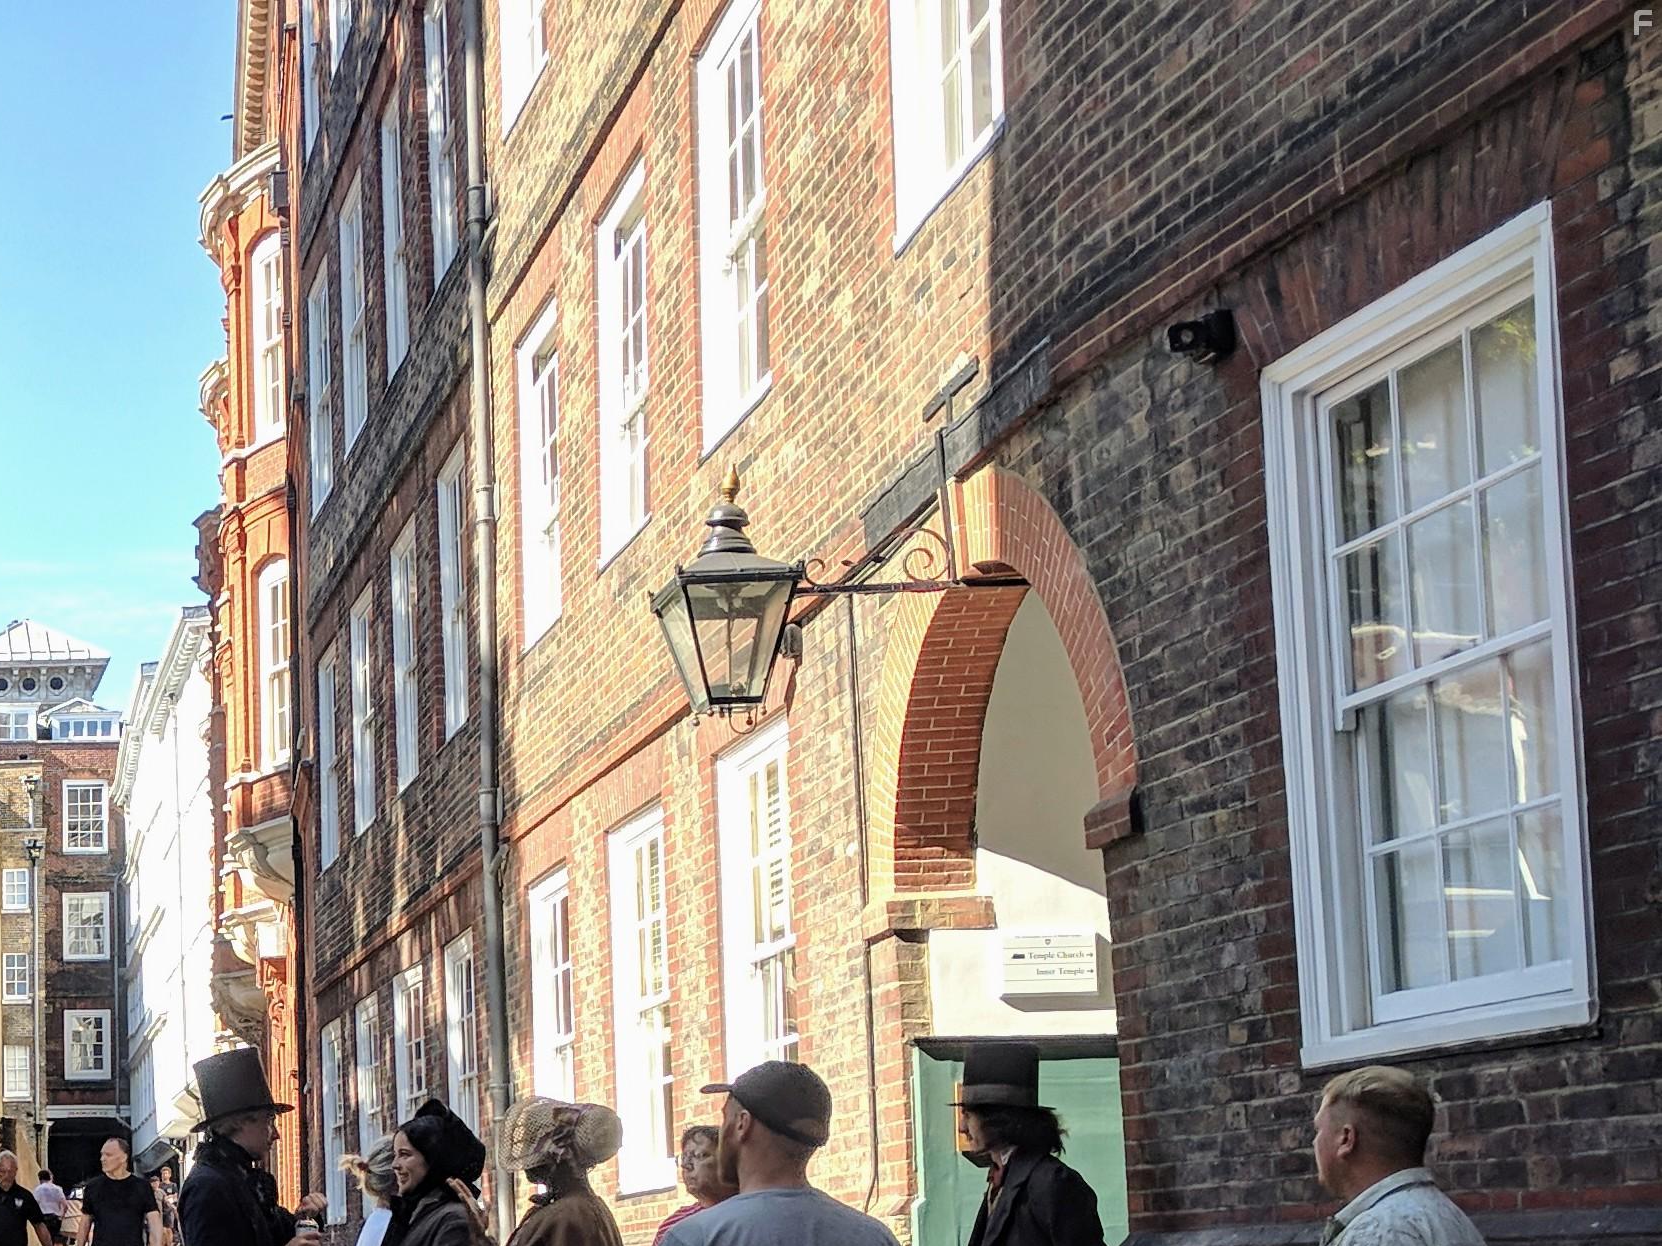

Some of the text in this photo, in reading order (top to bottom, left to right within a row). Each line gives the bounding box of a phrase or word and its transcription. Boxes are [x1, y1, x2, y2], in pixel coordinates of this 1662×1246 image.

[1027, 951, 1085, 960] Temple Church
[1058, 967, 1085, 976] Temple
